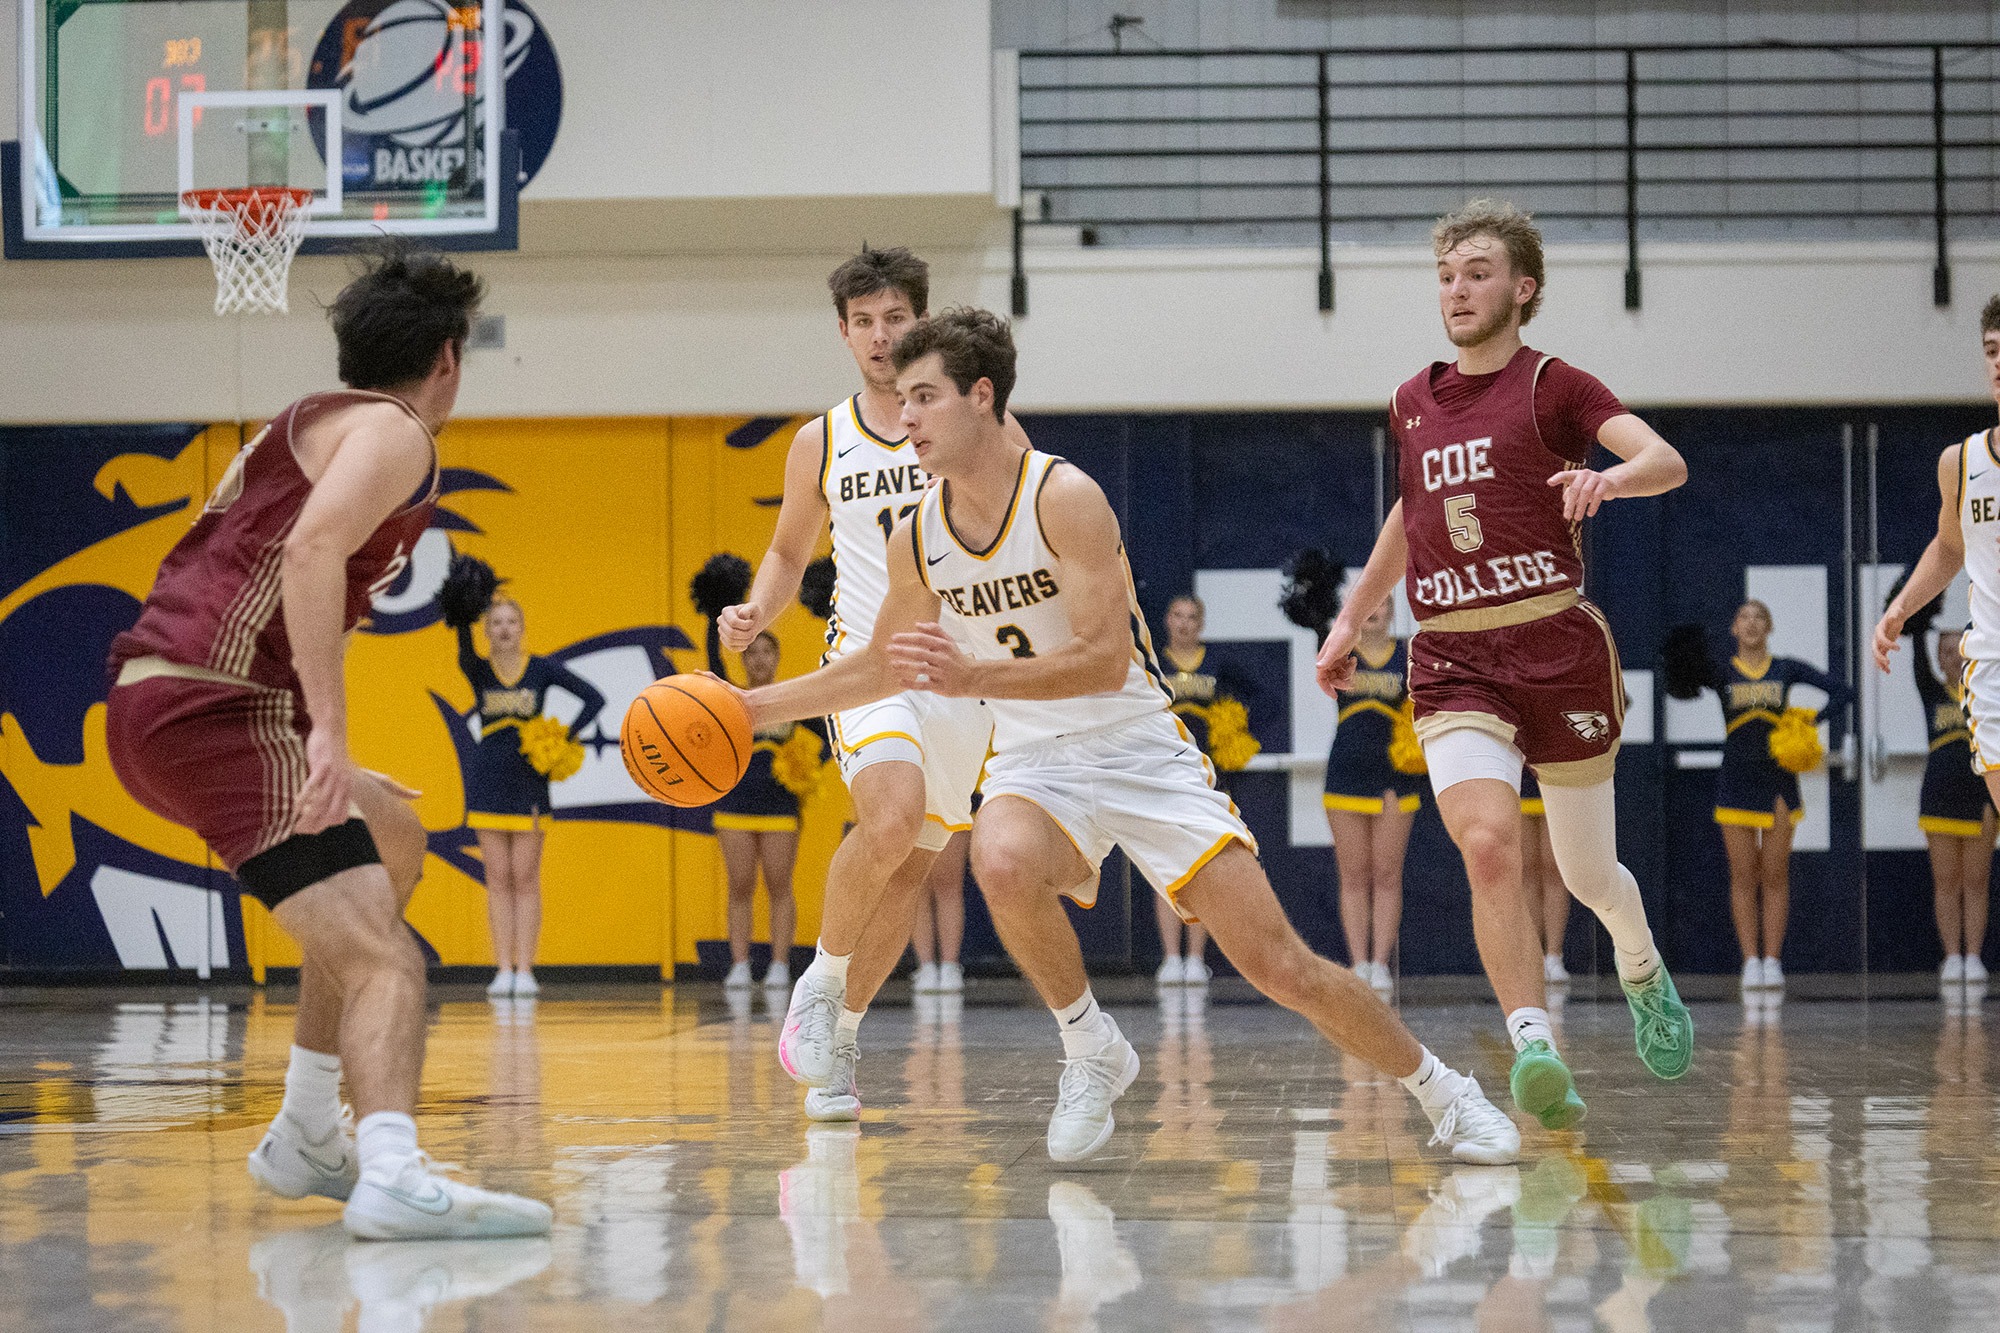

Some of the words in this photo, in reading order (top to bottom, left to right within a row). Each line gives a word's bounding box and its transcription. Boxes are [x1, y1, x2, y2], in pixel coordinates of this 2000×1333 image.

[840, 465, 933, 503] BEAVE
[1422, 436, 1495, 492] COE
[1444, 493, 1484, 554] 5
[1971, 496, 2000, 524] BE
[1415, 551, 1570, 606] COLLEGE
[641, 743, 685, 786] EVO
